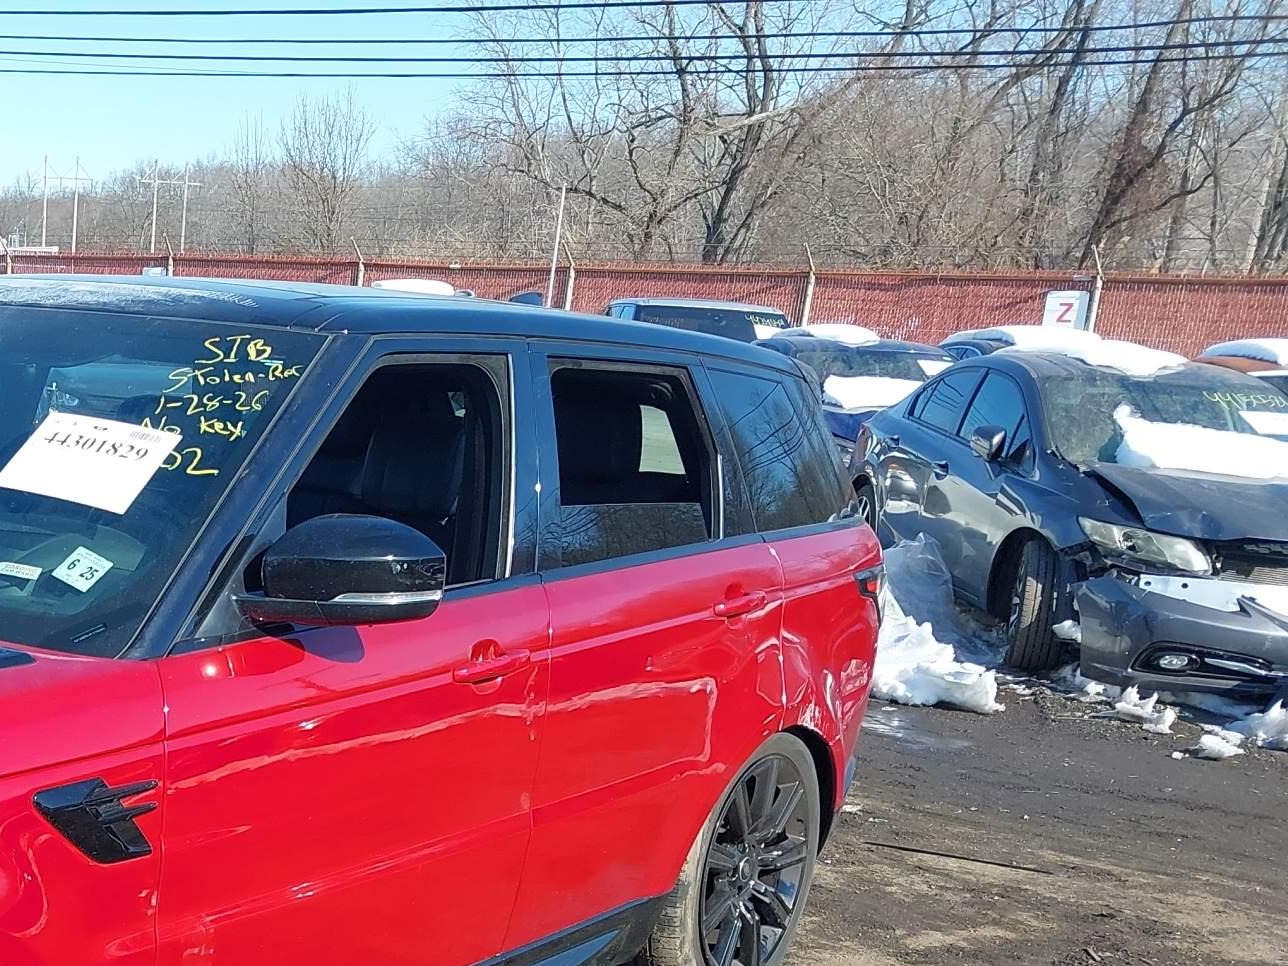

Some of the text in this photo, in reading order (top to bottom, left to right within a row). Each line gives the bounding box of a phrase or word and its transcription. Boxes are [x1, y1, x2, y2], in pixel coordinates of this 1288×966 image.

[1056, 303, 1074, 323] Z
[154, 390, 269, 415] 1-28-26
[44, 431, 149, 461] 44301829
[67, 558, 81, 571] 6
[79, 566, 100, 581] 25
